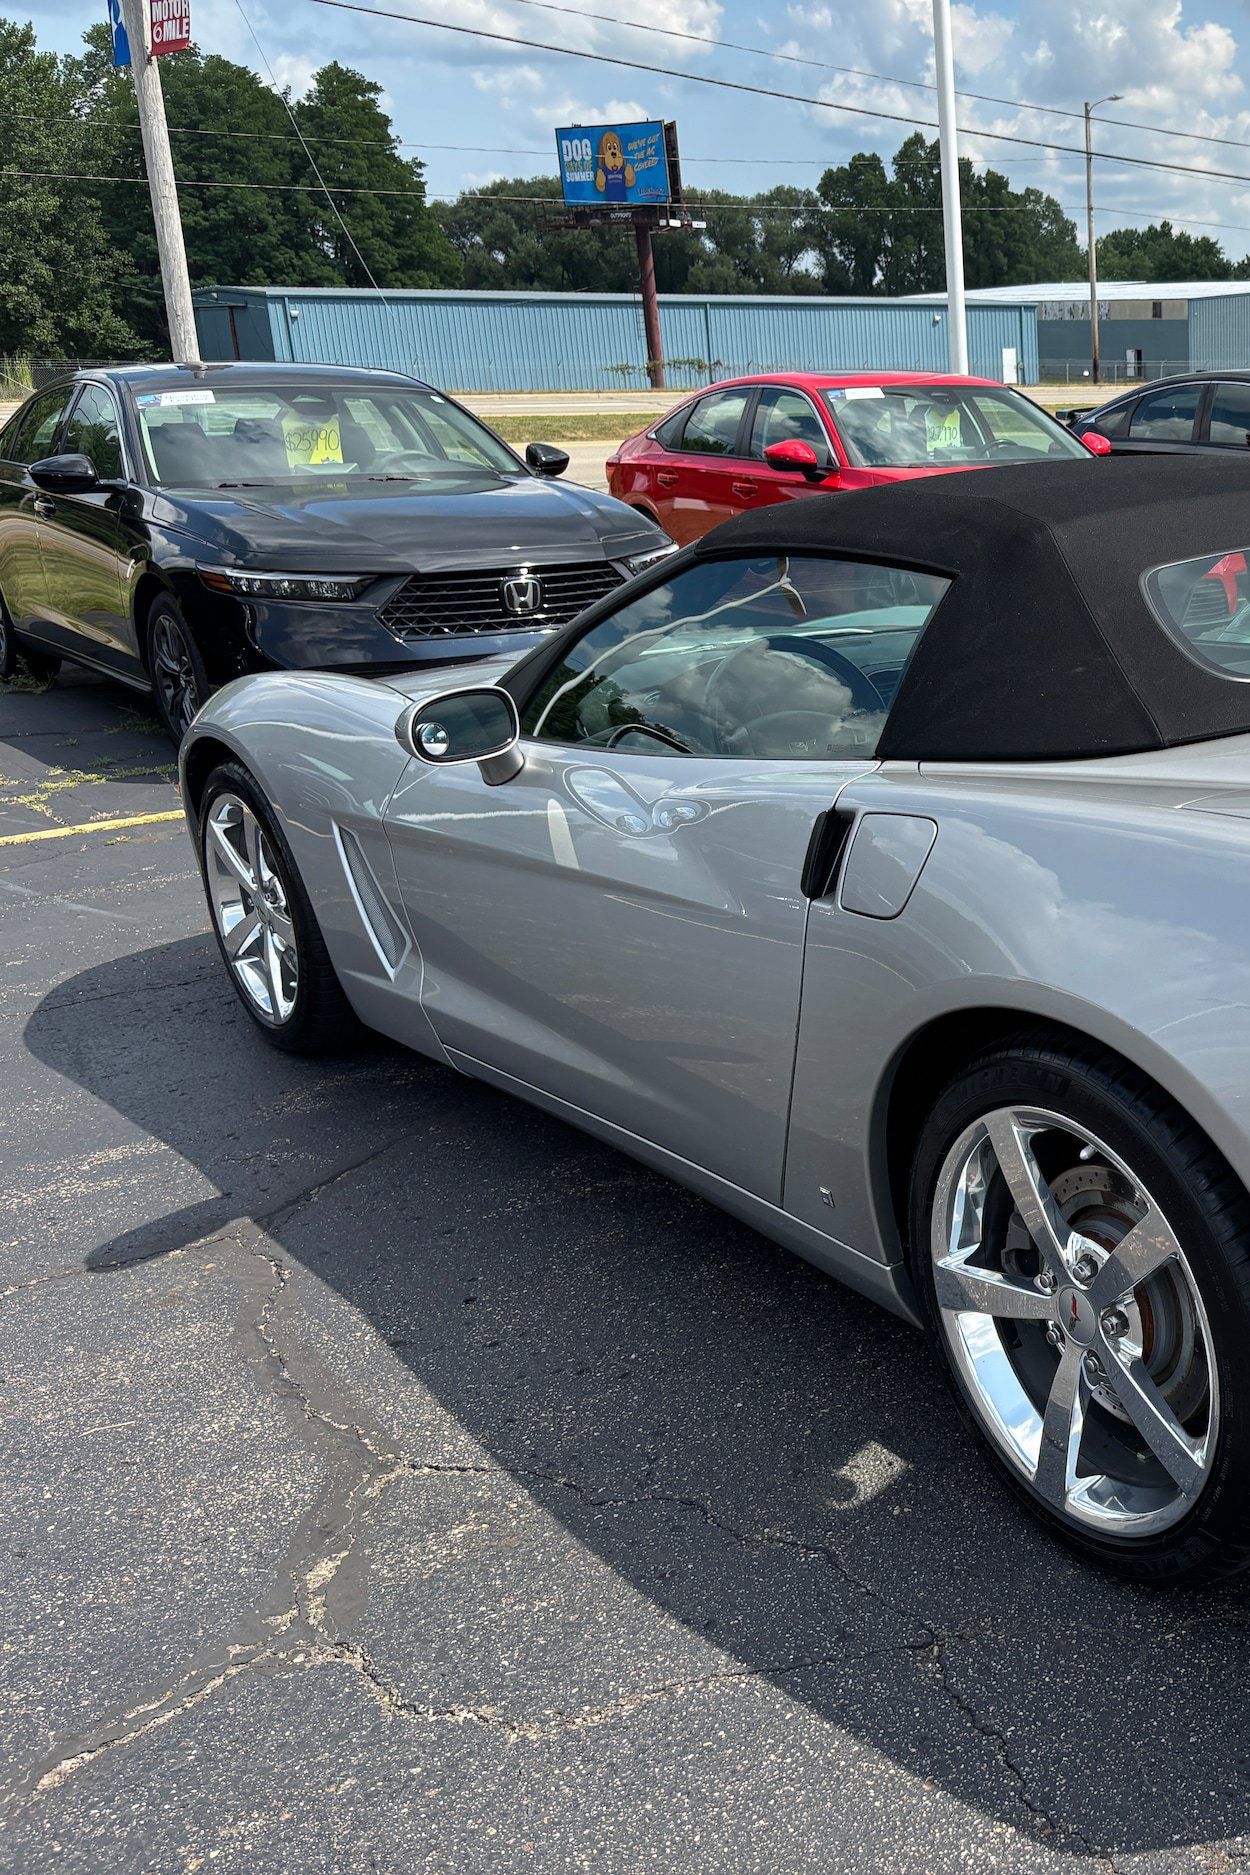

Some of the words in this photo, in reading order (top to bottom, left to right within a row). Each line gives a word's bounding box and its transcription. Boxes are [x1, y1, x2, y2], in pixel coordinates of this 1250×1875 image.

[152, 0, 190, 22] MOTOR
[562, 138, 592, 161] DOG
[566, 171, 595, 182] SUMMER
